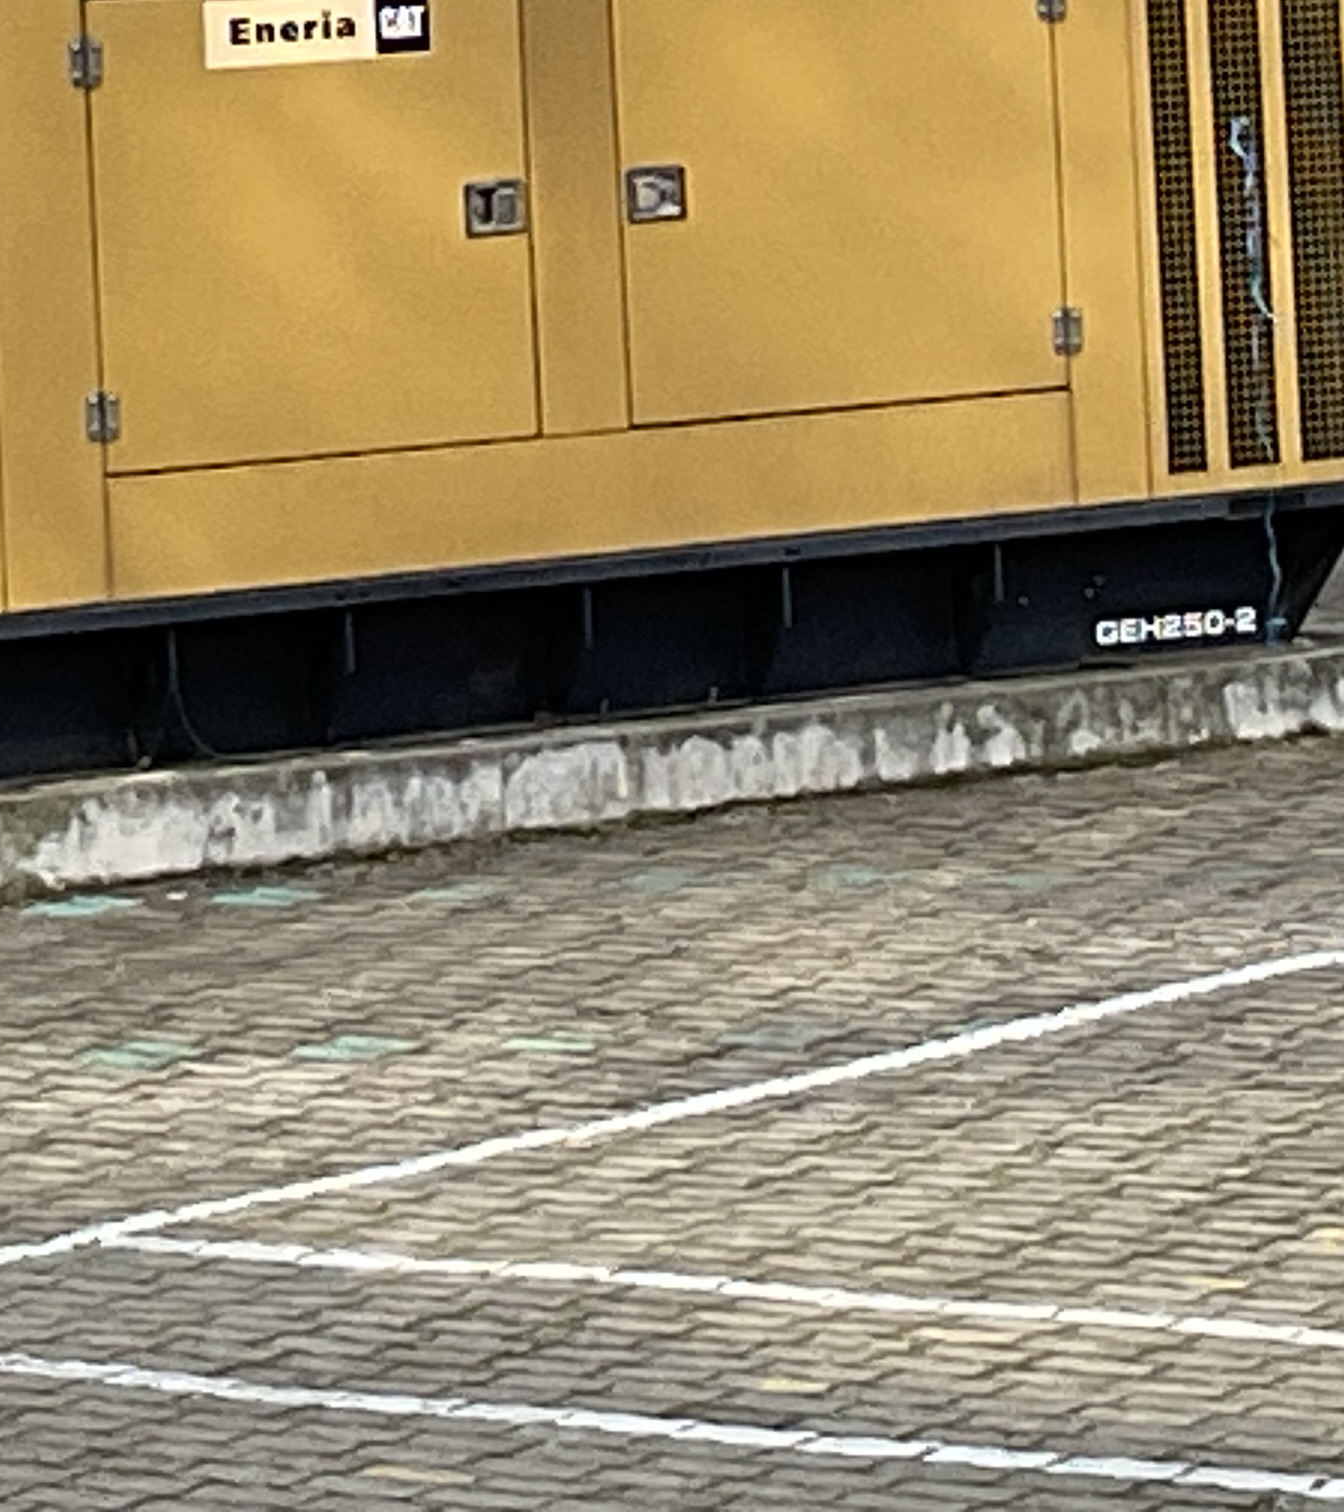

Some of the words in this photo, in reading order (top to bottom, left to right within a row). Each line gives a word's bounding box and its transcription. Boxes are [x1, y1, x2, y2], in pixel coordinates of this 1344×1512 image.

[228, 9, 357, 46] Eneria
[378, 5, 425, 40] CAT
[1095, 606, 1257, 646] GEH250-2
